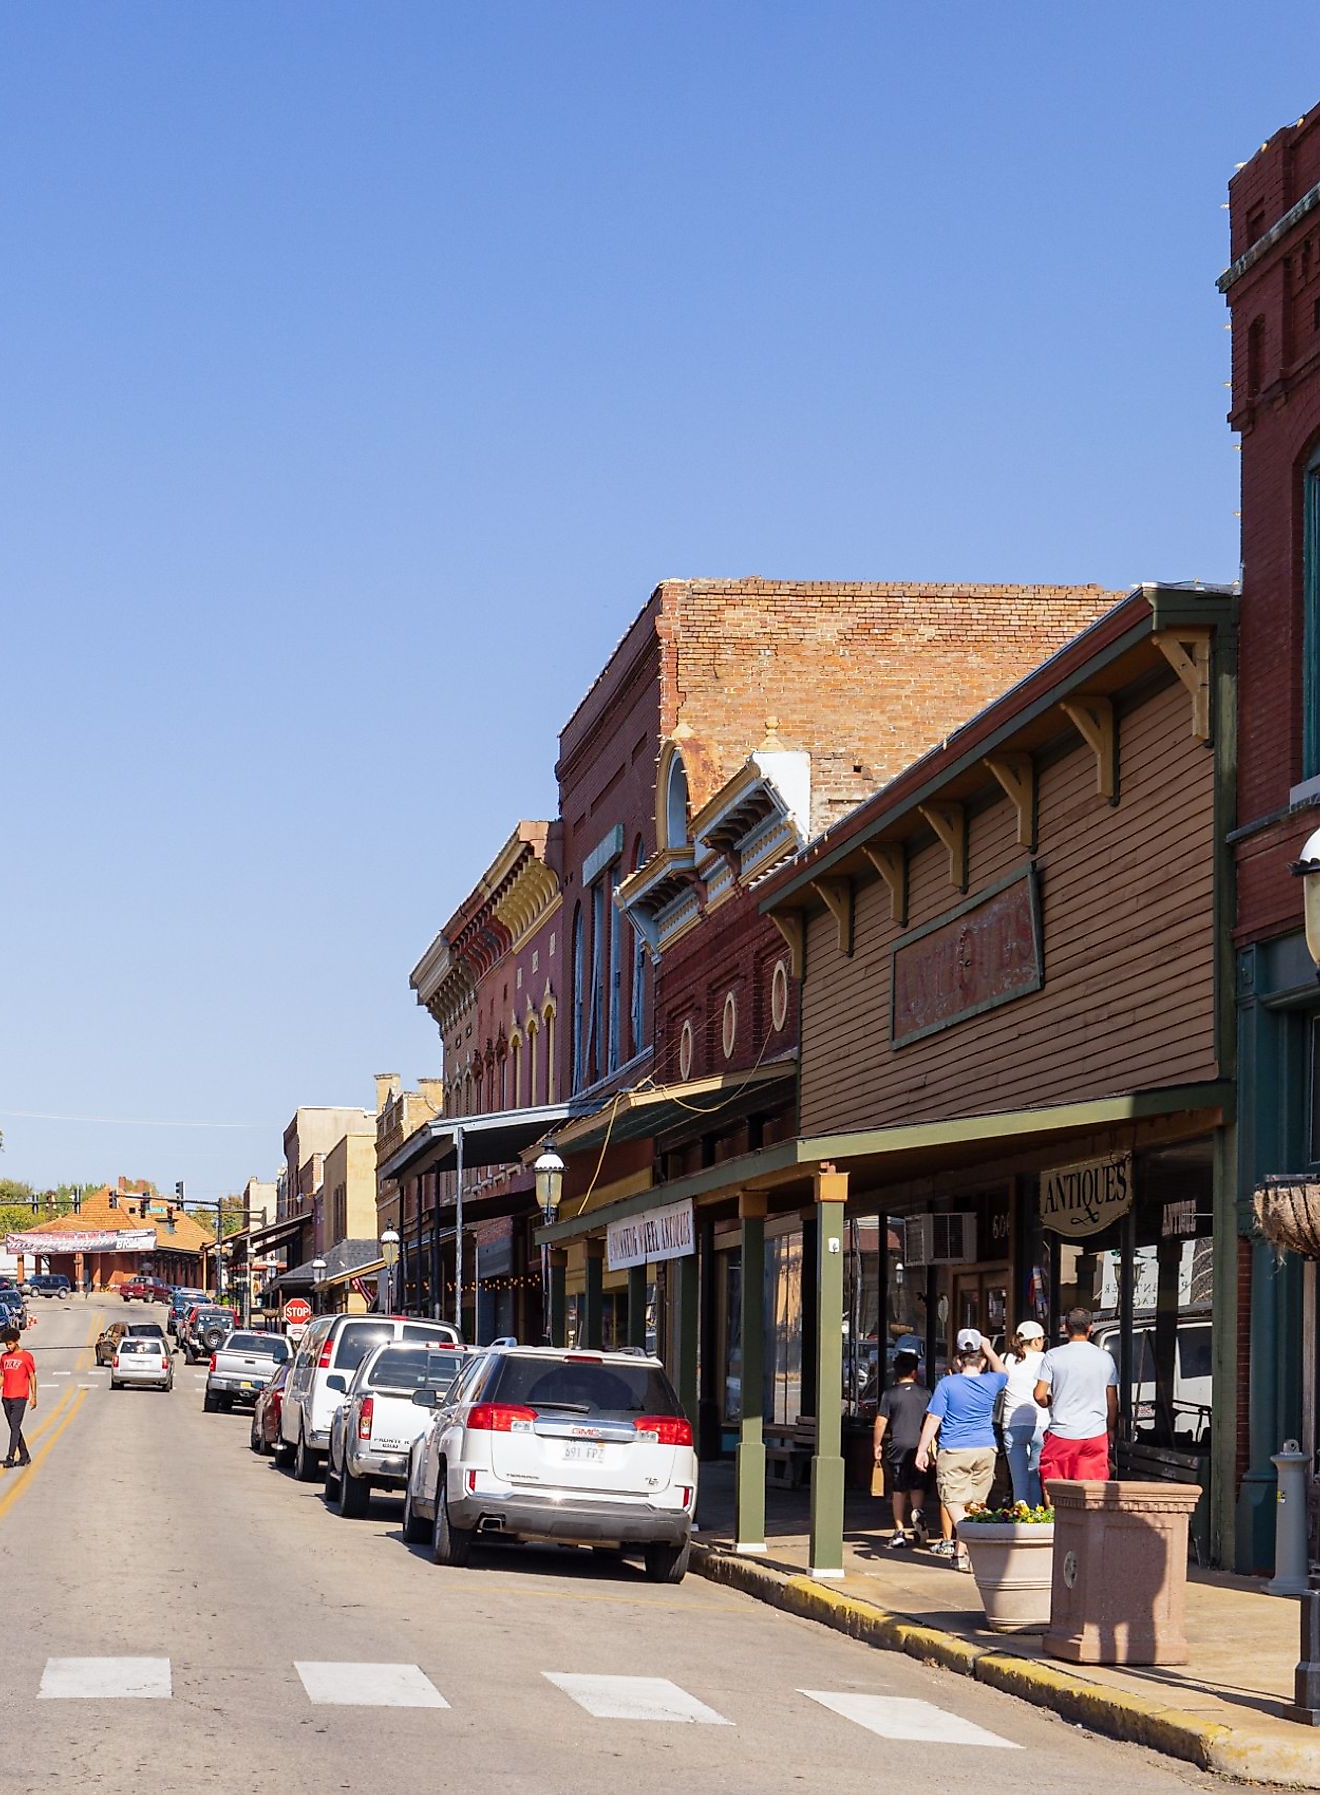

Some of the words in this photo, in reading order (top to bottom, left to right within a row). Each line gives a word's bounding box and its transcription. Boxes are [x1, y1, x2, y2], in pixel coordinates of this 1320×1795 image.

[1044, 1163, 1127, 1216] ANTIQUES
[286, 1307, 309, 1317] STOP
[572, 1427, 600, 1437] GMC
